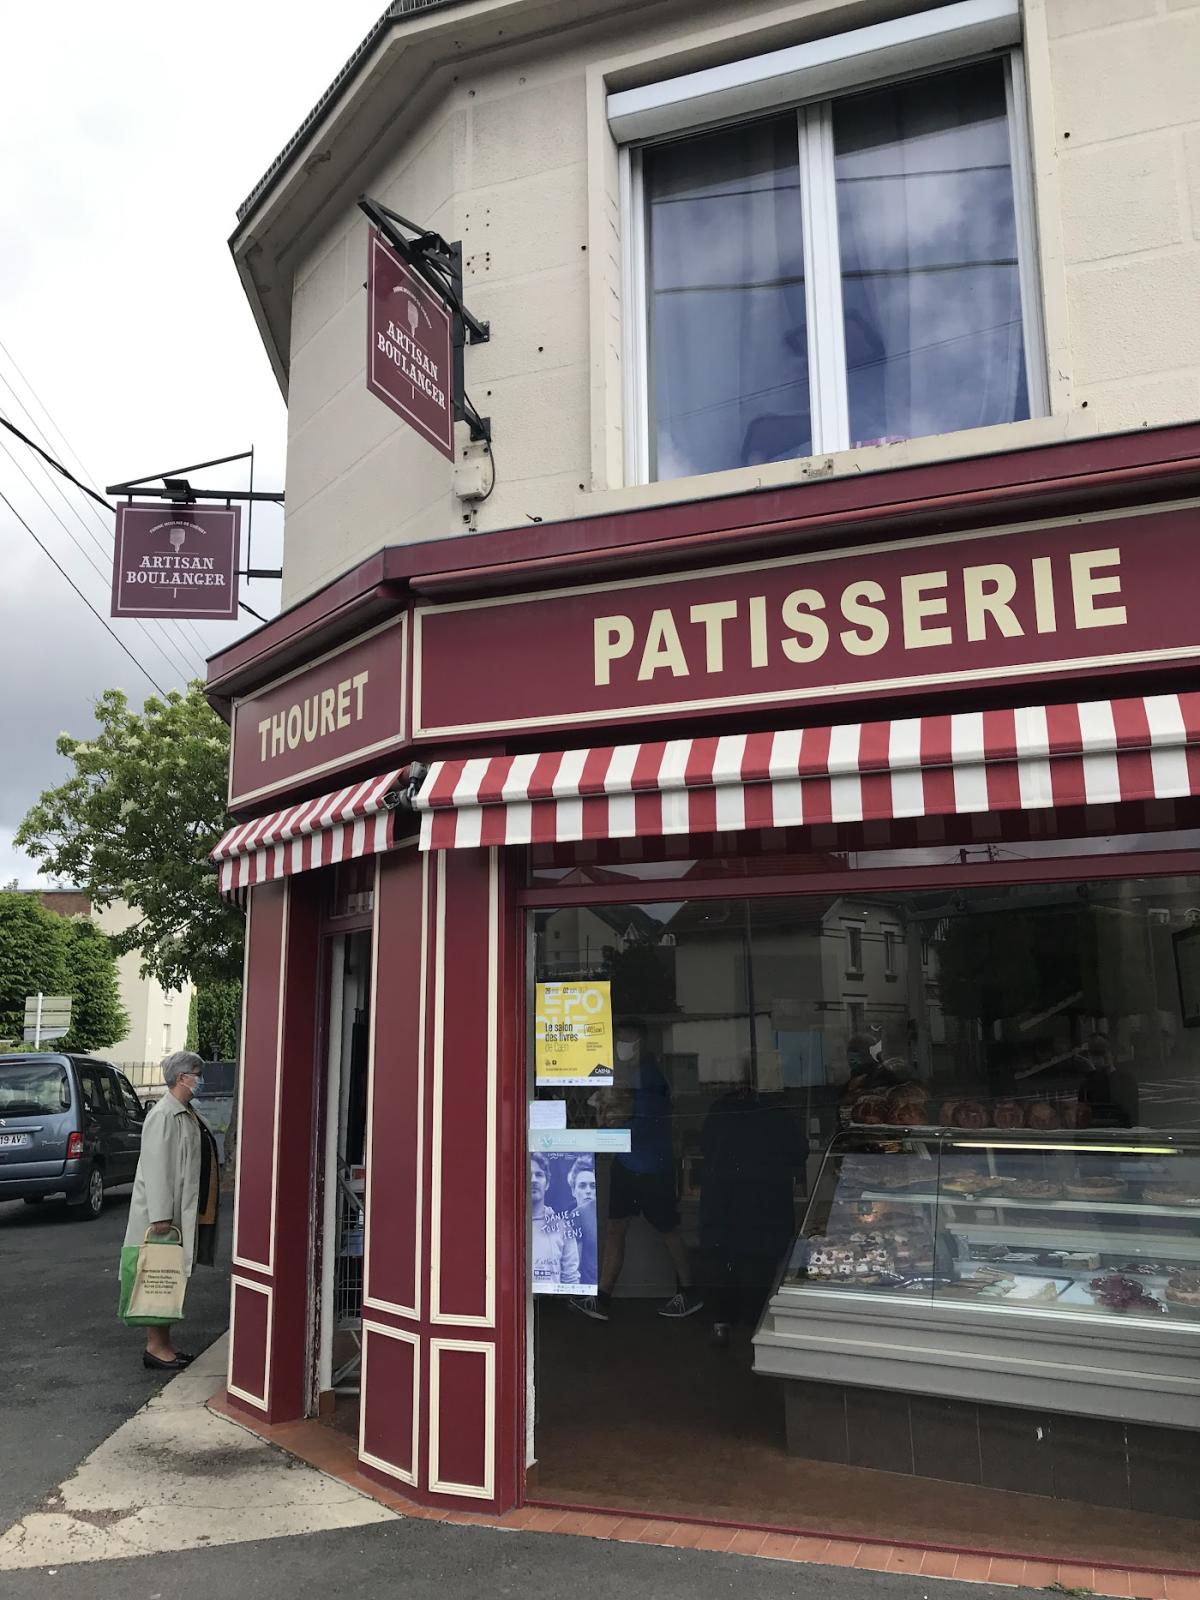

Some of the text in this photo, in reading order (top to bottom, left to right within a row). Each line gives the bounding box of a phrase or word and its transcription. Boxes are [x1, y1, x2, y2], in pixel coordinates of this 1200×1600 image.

[386, 320, 438, 382] ARTISAN
[377, 331, 446, 410] BOULANGER
[139, 555, 215, 570] ARTISAN
[126, 571, 226, 586] BOULANGER
[593, 547, 1128, 686] PATISSERIE
[258, 670, 369, 762] THOURET
[554, 1020, 573, 1032] salon
[545, 1032, 558, 1042] des
[545, 1210, 569, 1224] DANSE
[541, 1222, 561, 1234] TOUS
[563, 1226, 583, 1240] SENS
